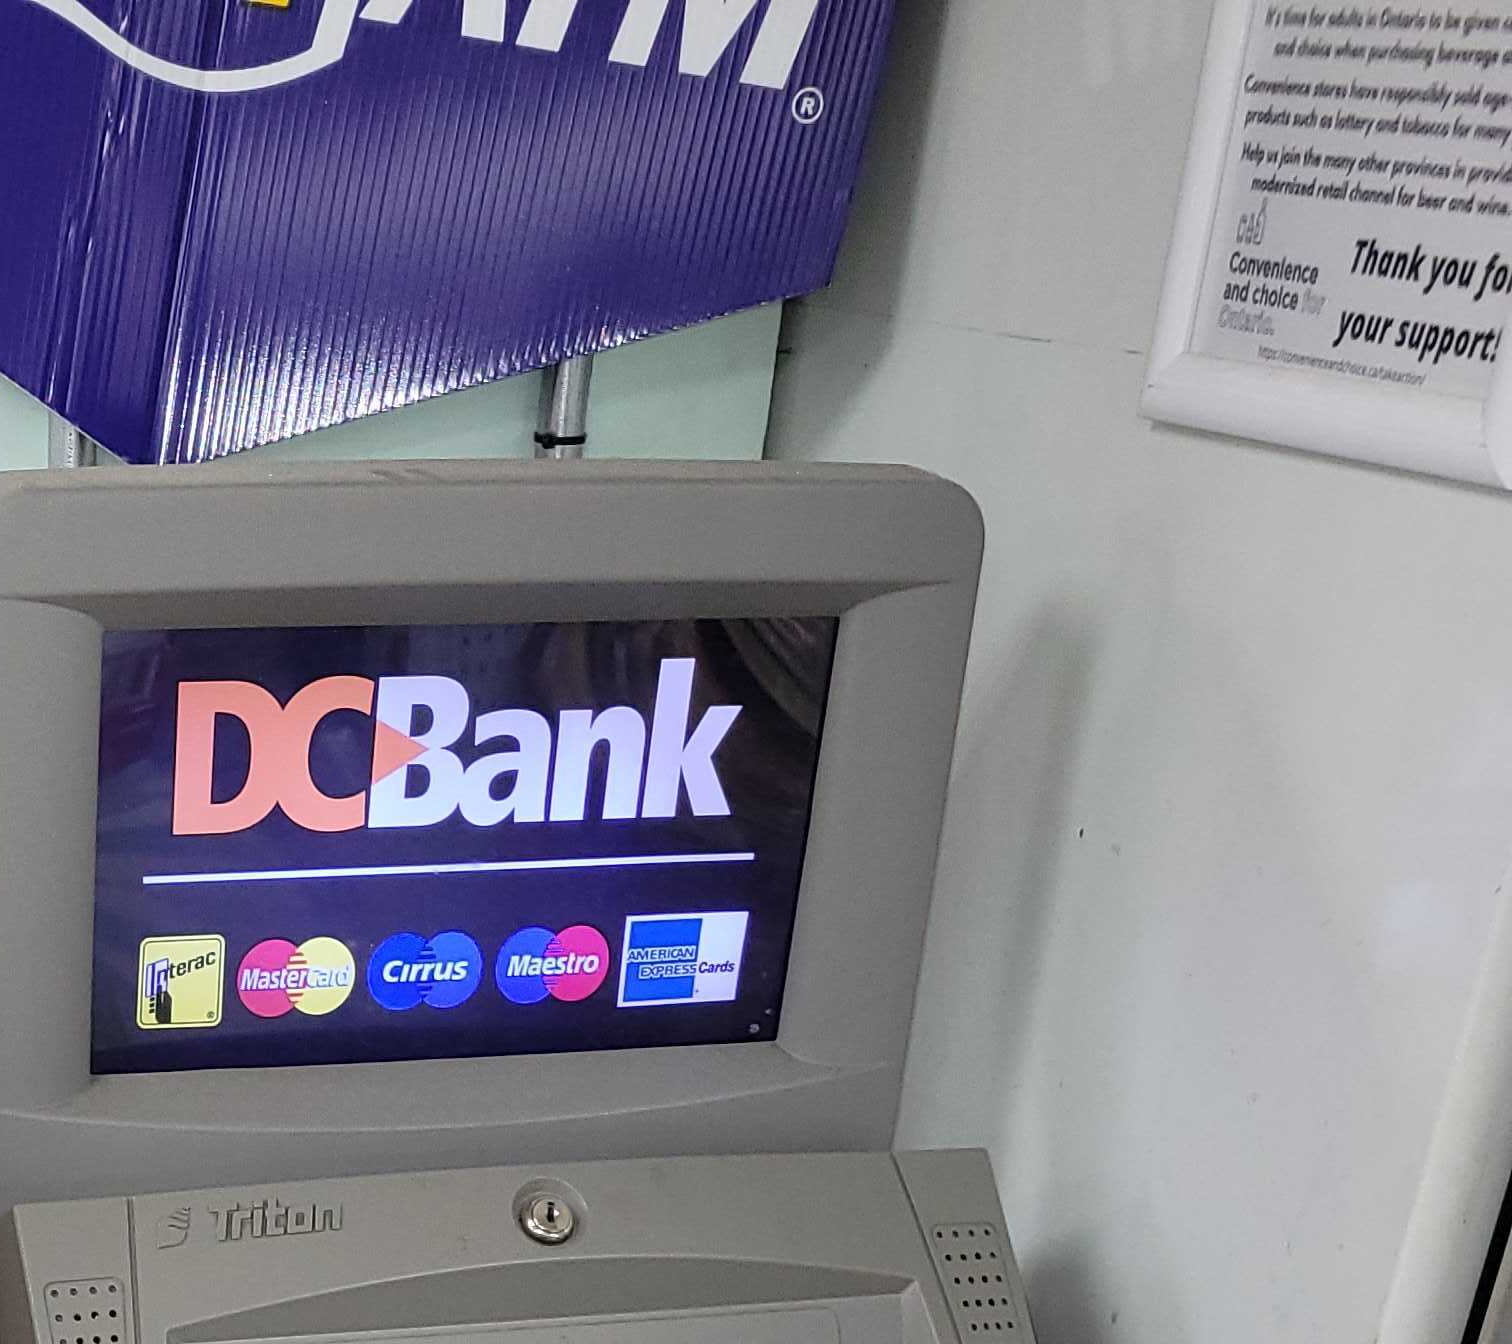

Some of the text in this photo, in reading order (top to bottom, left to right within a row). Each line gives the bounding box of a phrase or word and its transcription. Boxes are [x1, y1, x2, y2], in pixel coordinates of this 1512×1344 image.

[1273, 37, 1295, 56] and
[1336, 40, 1365, 57] when
[1367, 40, 1434, 70] purchasing
[1438, 41, 1498, 70] beverage
[1244, 74, 1481, 109] Convenience stores have responsibly sold
[1244, 105, 1511, 147] products such as lottery and tobacco for many
[1241, 142, 1465, 179] Help us join the many other provinces in
[1251, 174, 1511, 216] modernized retail channel for beer and wine.
[1228, 251, 1319, 285] Convenience
[1350, 238, 1426, 282] Thank
[1422, 255, 1478, 295] you
[1223, 281, 1299, 310] and choice
[1332, 310, 1503, 364] your support!
[172, 658, 743, 835] DCBank
[382, 958, 469, 983] Cirrus
[506, 953, 600, 978] Maestro
[627, 946, 696, 961] AMERICAN
[639, 961, 735, 979] EXPRESS Cards
[240, 964, 352, 992] MasterCard
[208, 1197, 344, 1242] Triton
